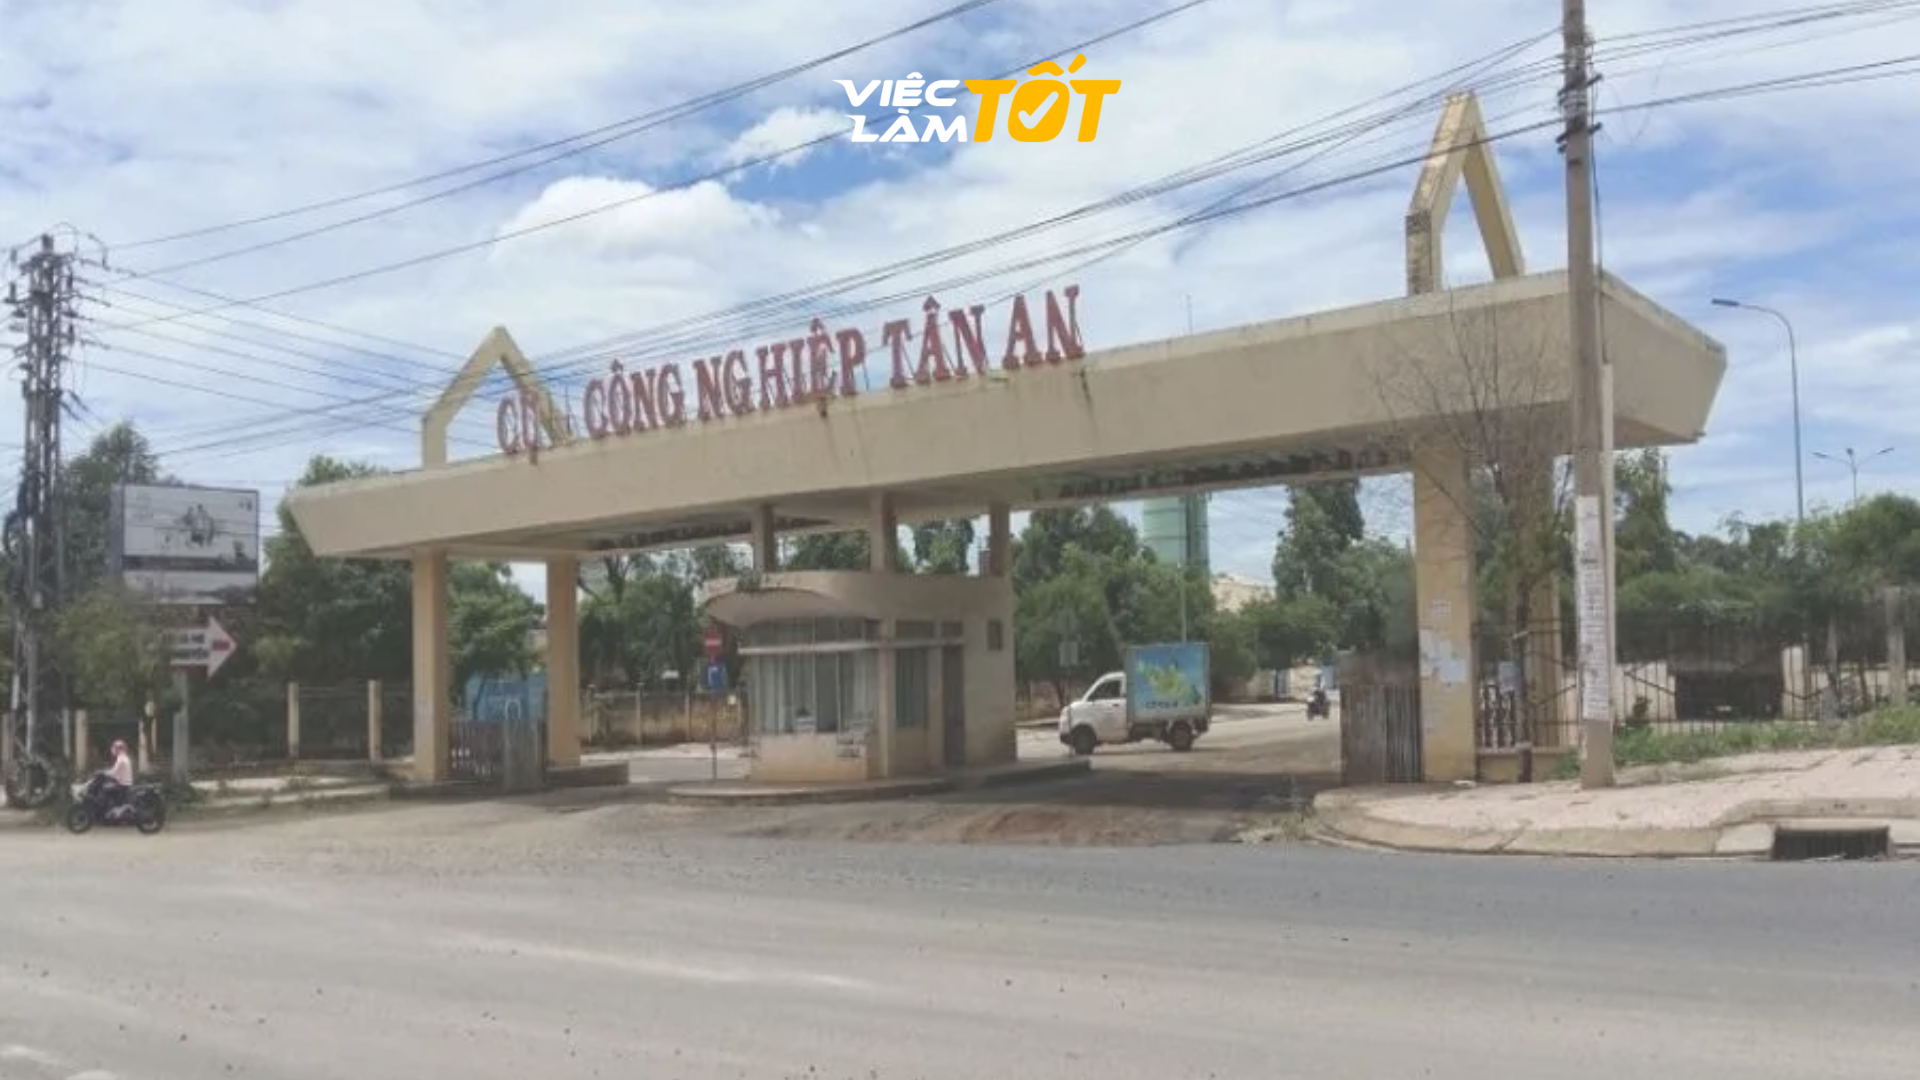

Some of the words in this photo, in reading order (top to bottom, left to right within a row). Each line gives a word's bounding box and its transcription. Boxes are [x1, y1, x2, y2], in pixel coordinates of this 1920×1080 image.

[584, 358, 685, 438] CÔNG
[692, 317, 867, 419] NGHIỆP
[882, 295, 989, 389] TÂN
[1002, 284, 1086, 371] AN
